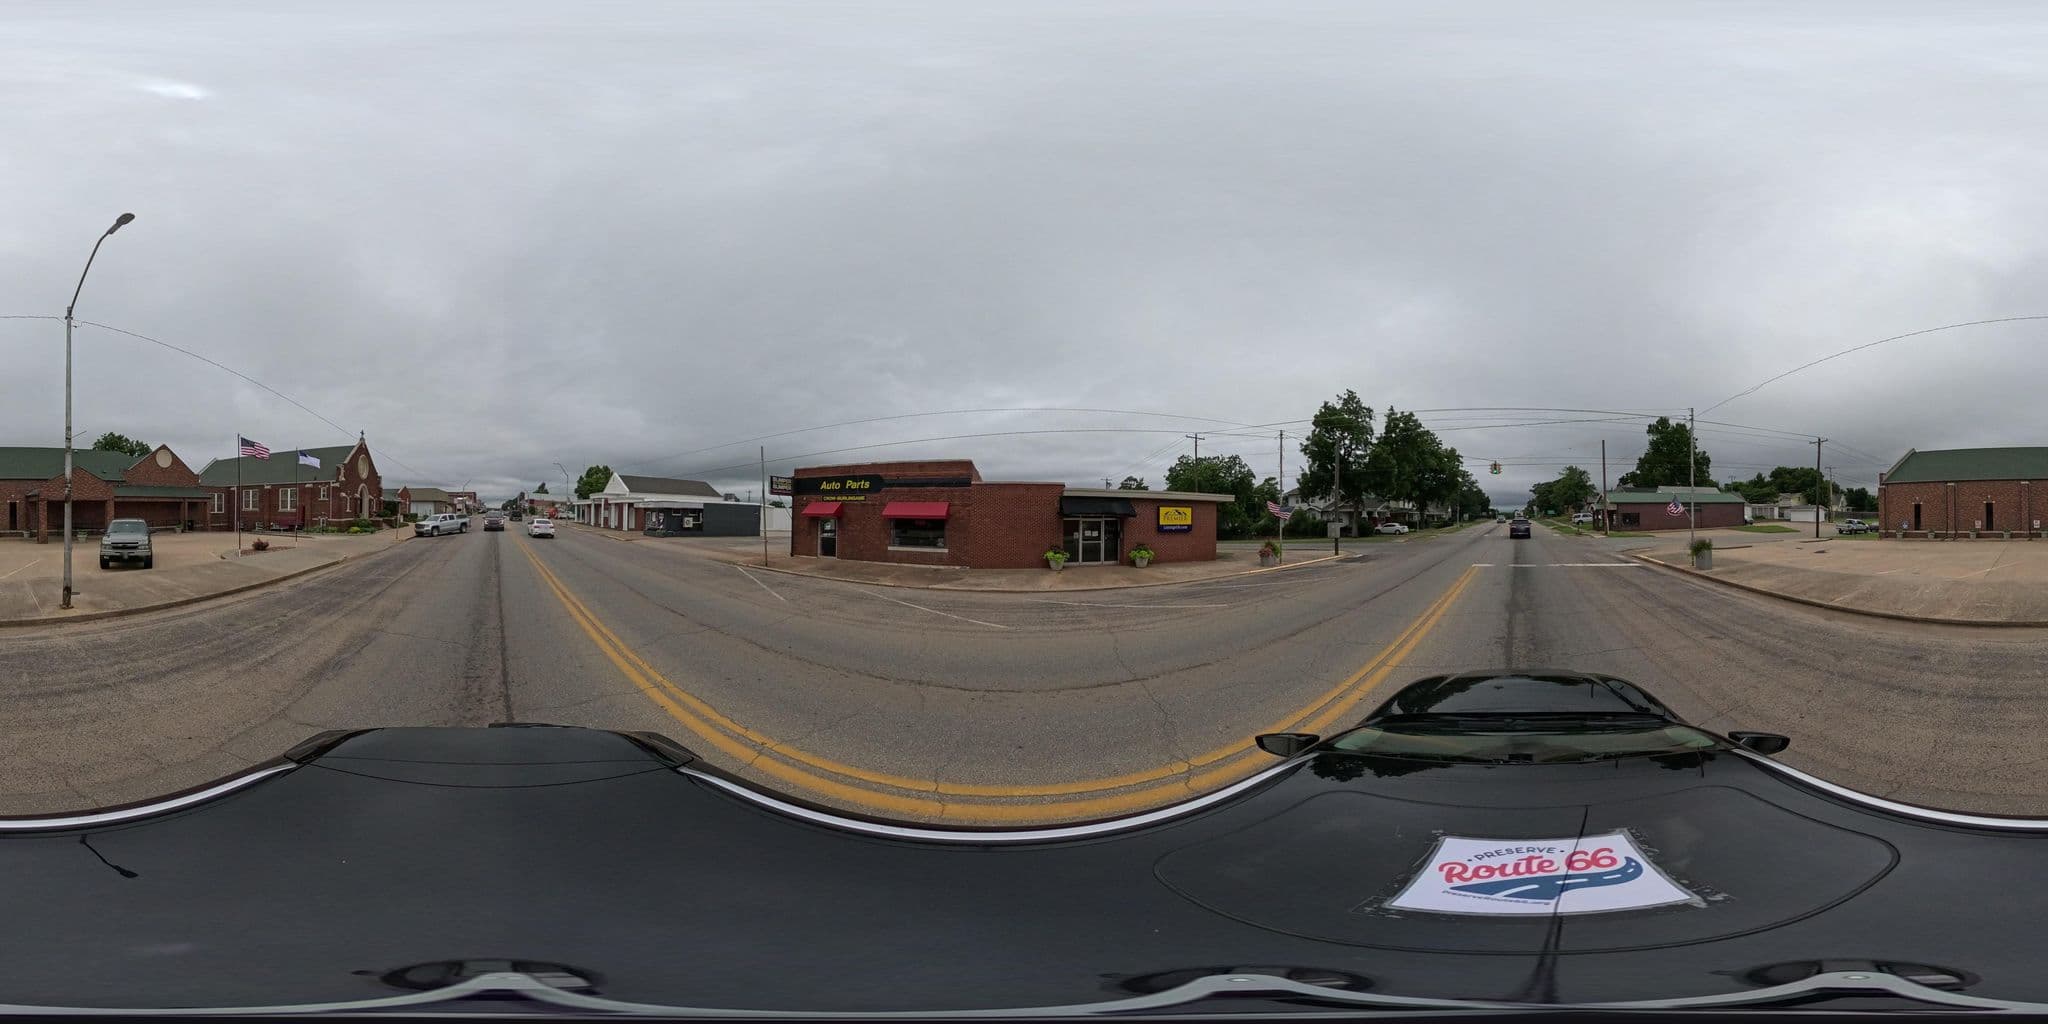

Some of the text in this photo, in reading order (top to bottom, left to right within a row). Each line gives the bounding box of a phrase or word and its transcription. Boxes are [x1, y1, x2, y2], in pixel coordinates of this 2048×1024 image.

[820, 480, 870, 490] Auto Parts
[1474, 846, 1557, 861] PRESERVE
[1438, 847, 1618, 884] Route 66
